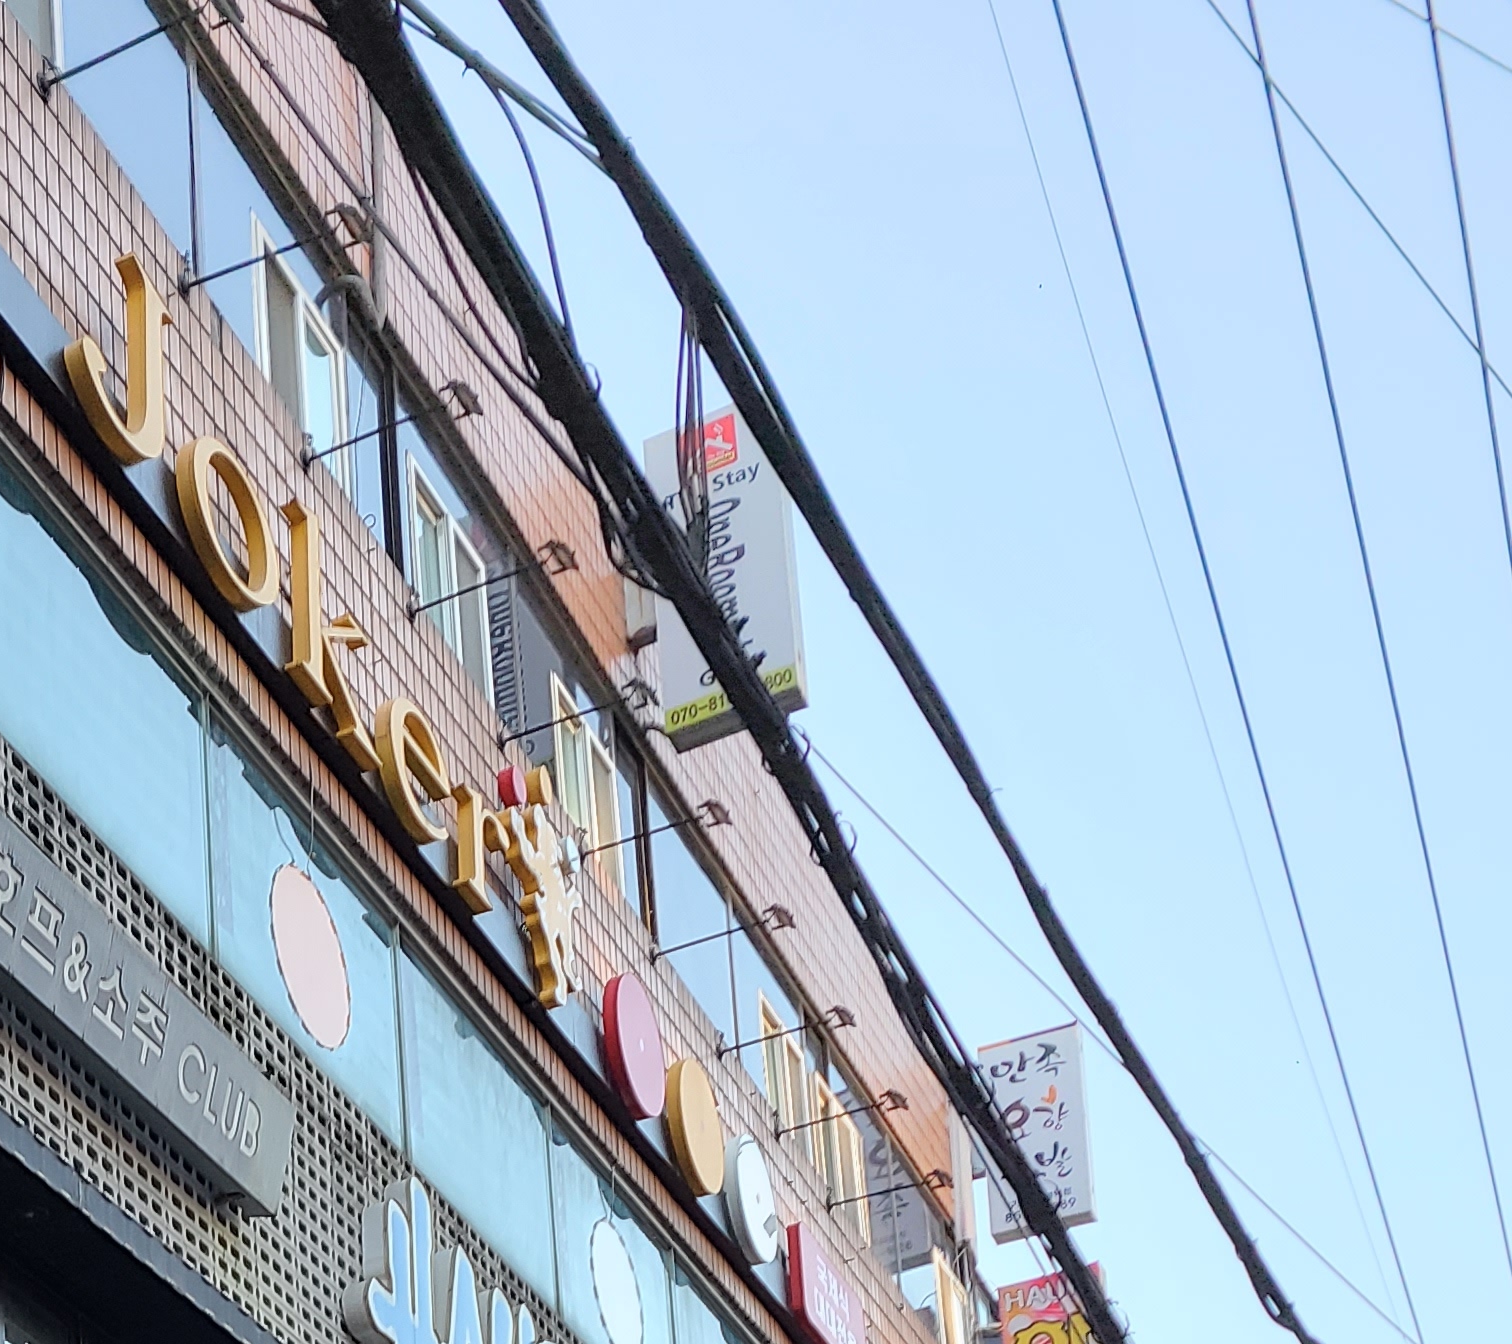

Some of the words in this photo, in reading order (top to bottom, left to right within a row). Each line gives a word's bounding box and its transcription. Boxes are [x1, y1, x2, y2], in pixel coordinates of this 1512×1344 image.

[712, 462, 761, 492] Stay
[991, 1043, 1066, 1084] 만족
[176, 1044, 264, 1161] CLUB
